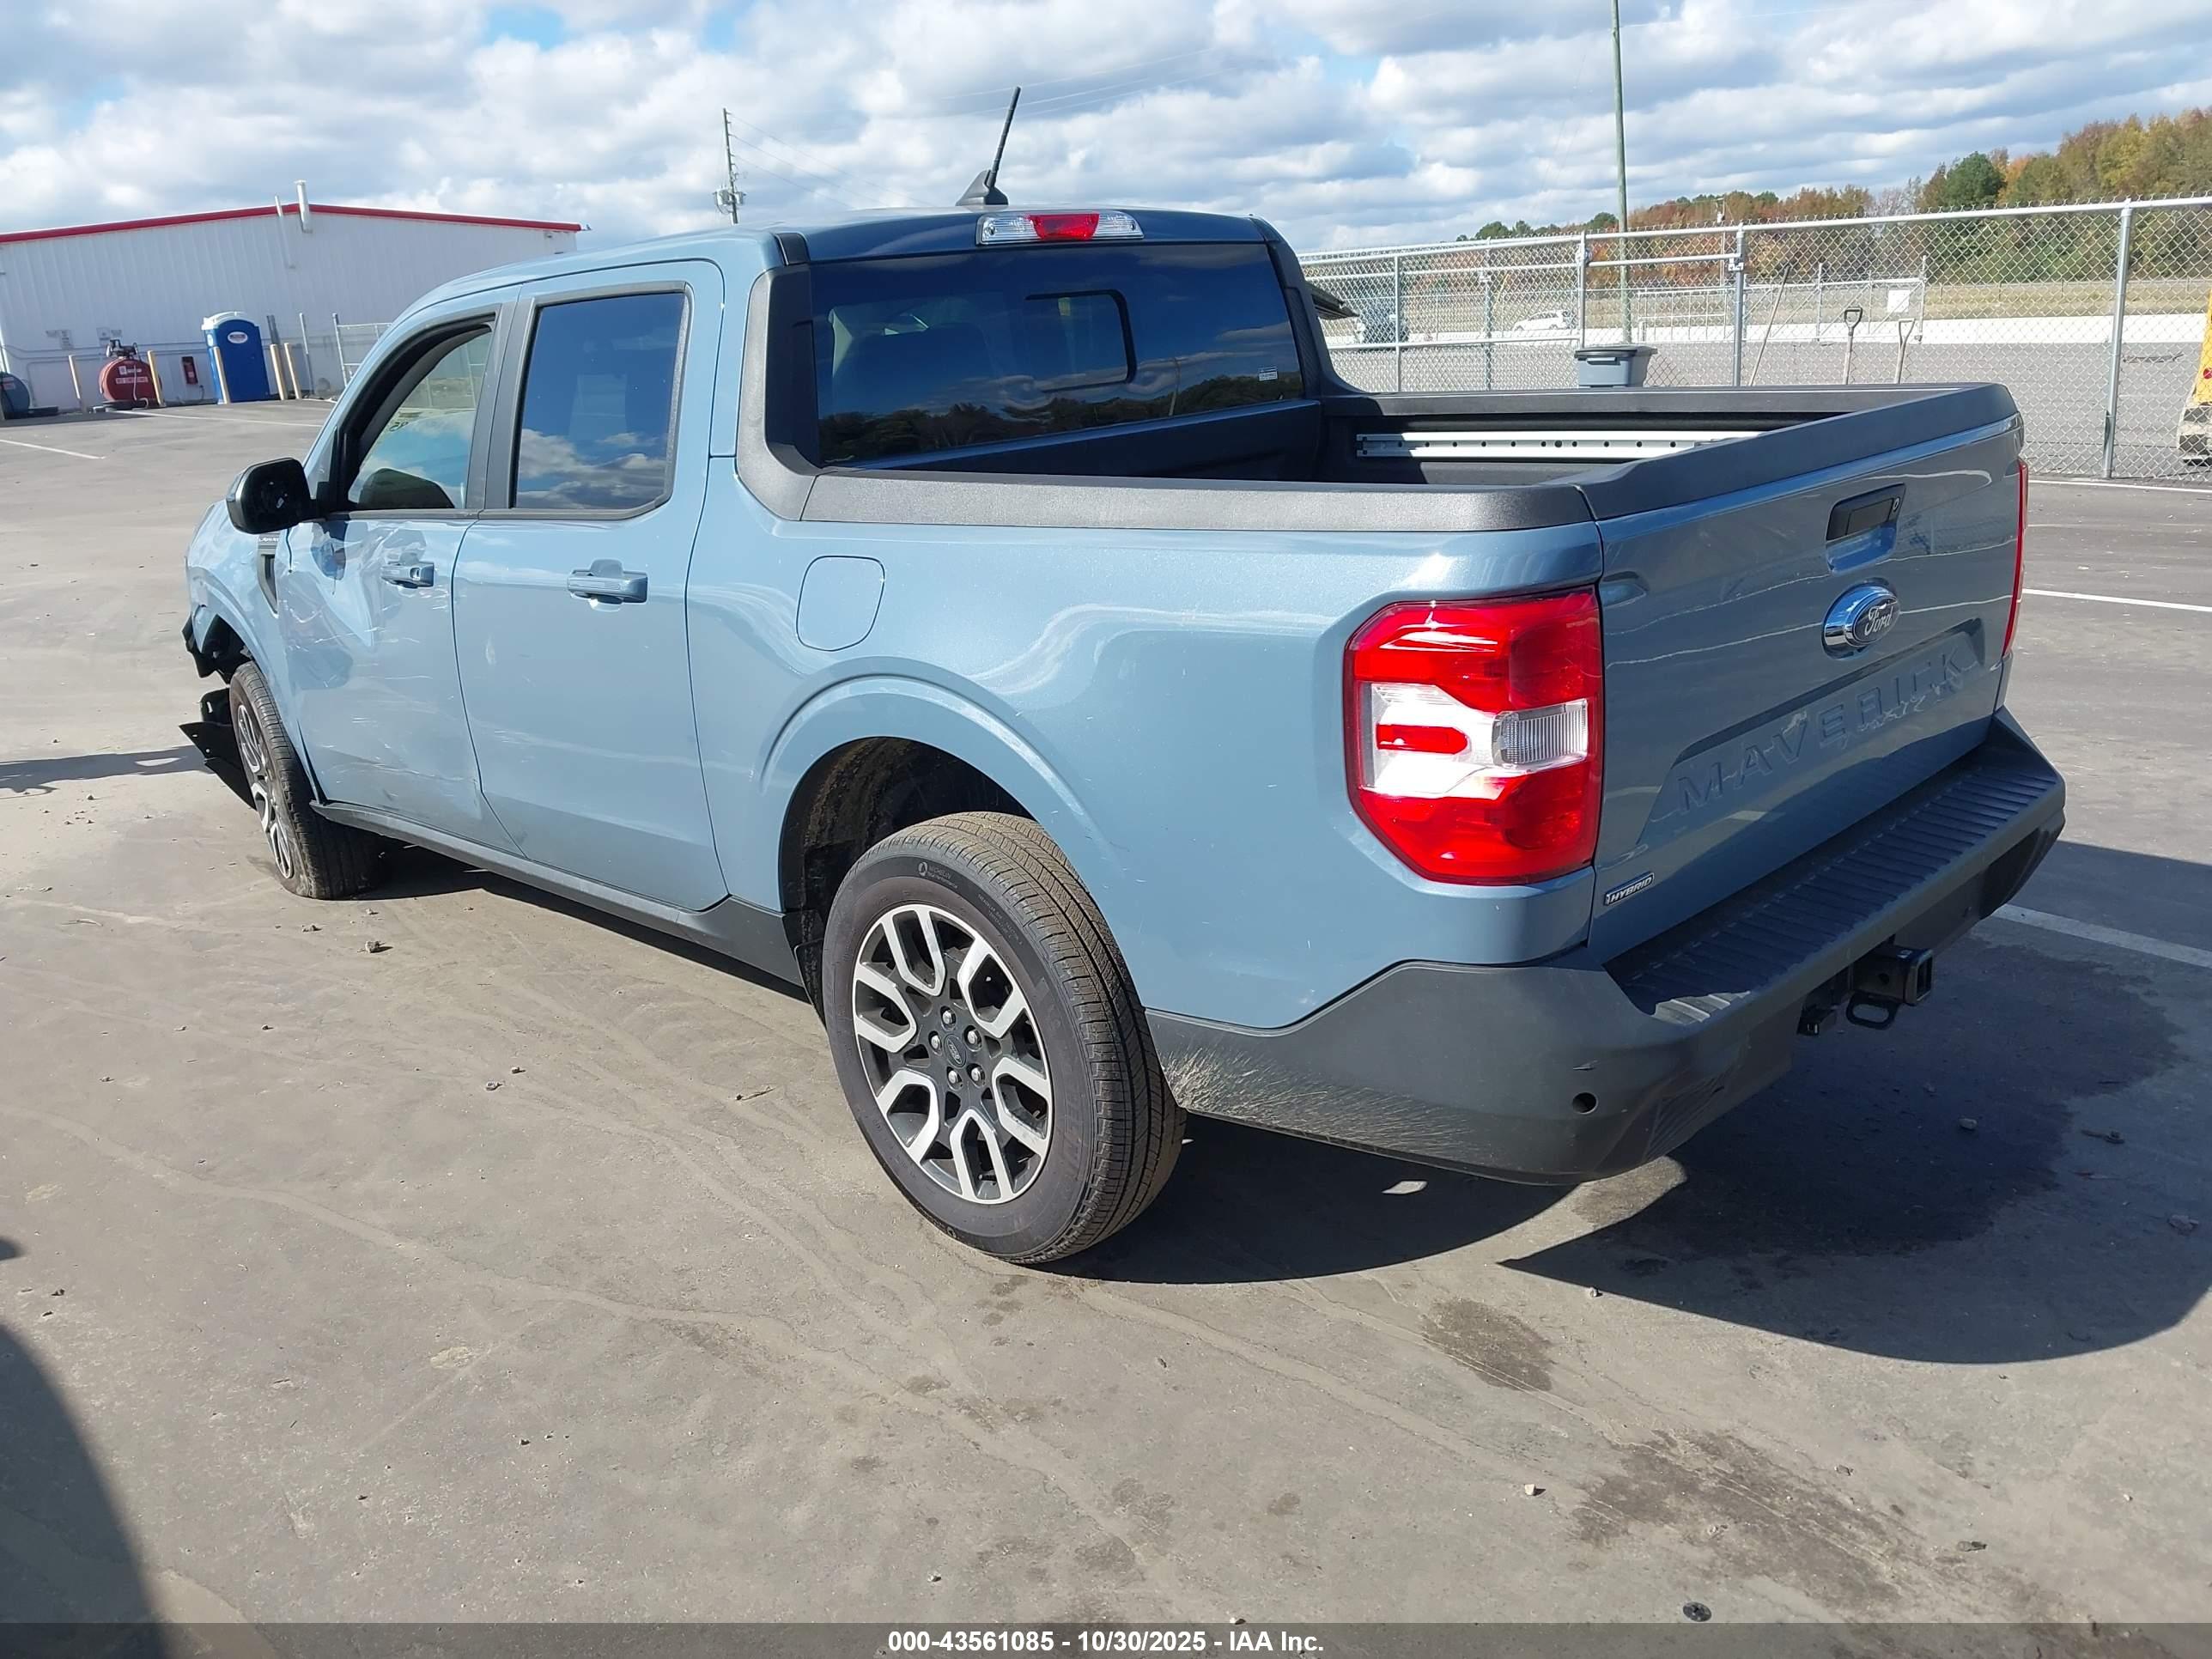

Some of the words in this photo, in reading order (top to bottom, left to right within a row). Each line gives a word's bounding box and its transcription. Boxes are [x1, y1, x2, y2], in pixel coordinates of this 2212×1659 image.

[1863, 603, 1893, 636] Ford
[1676, 647, 1963, 813] MAVERICK
[1610, 876, 1653, 903] HYBRID
